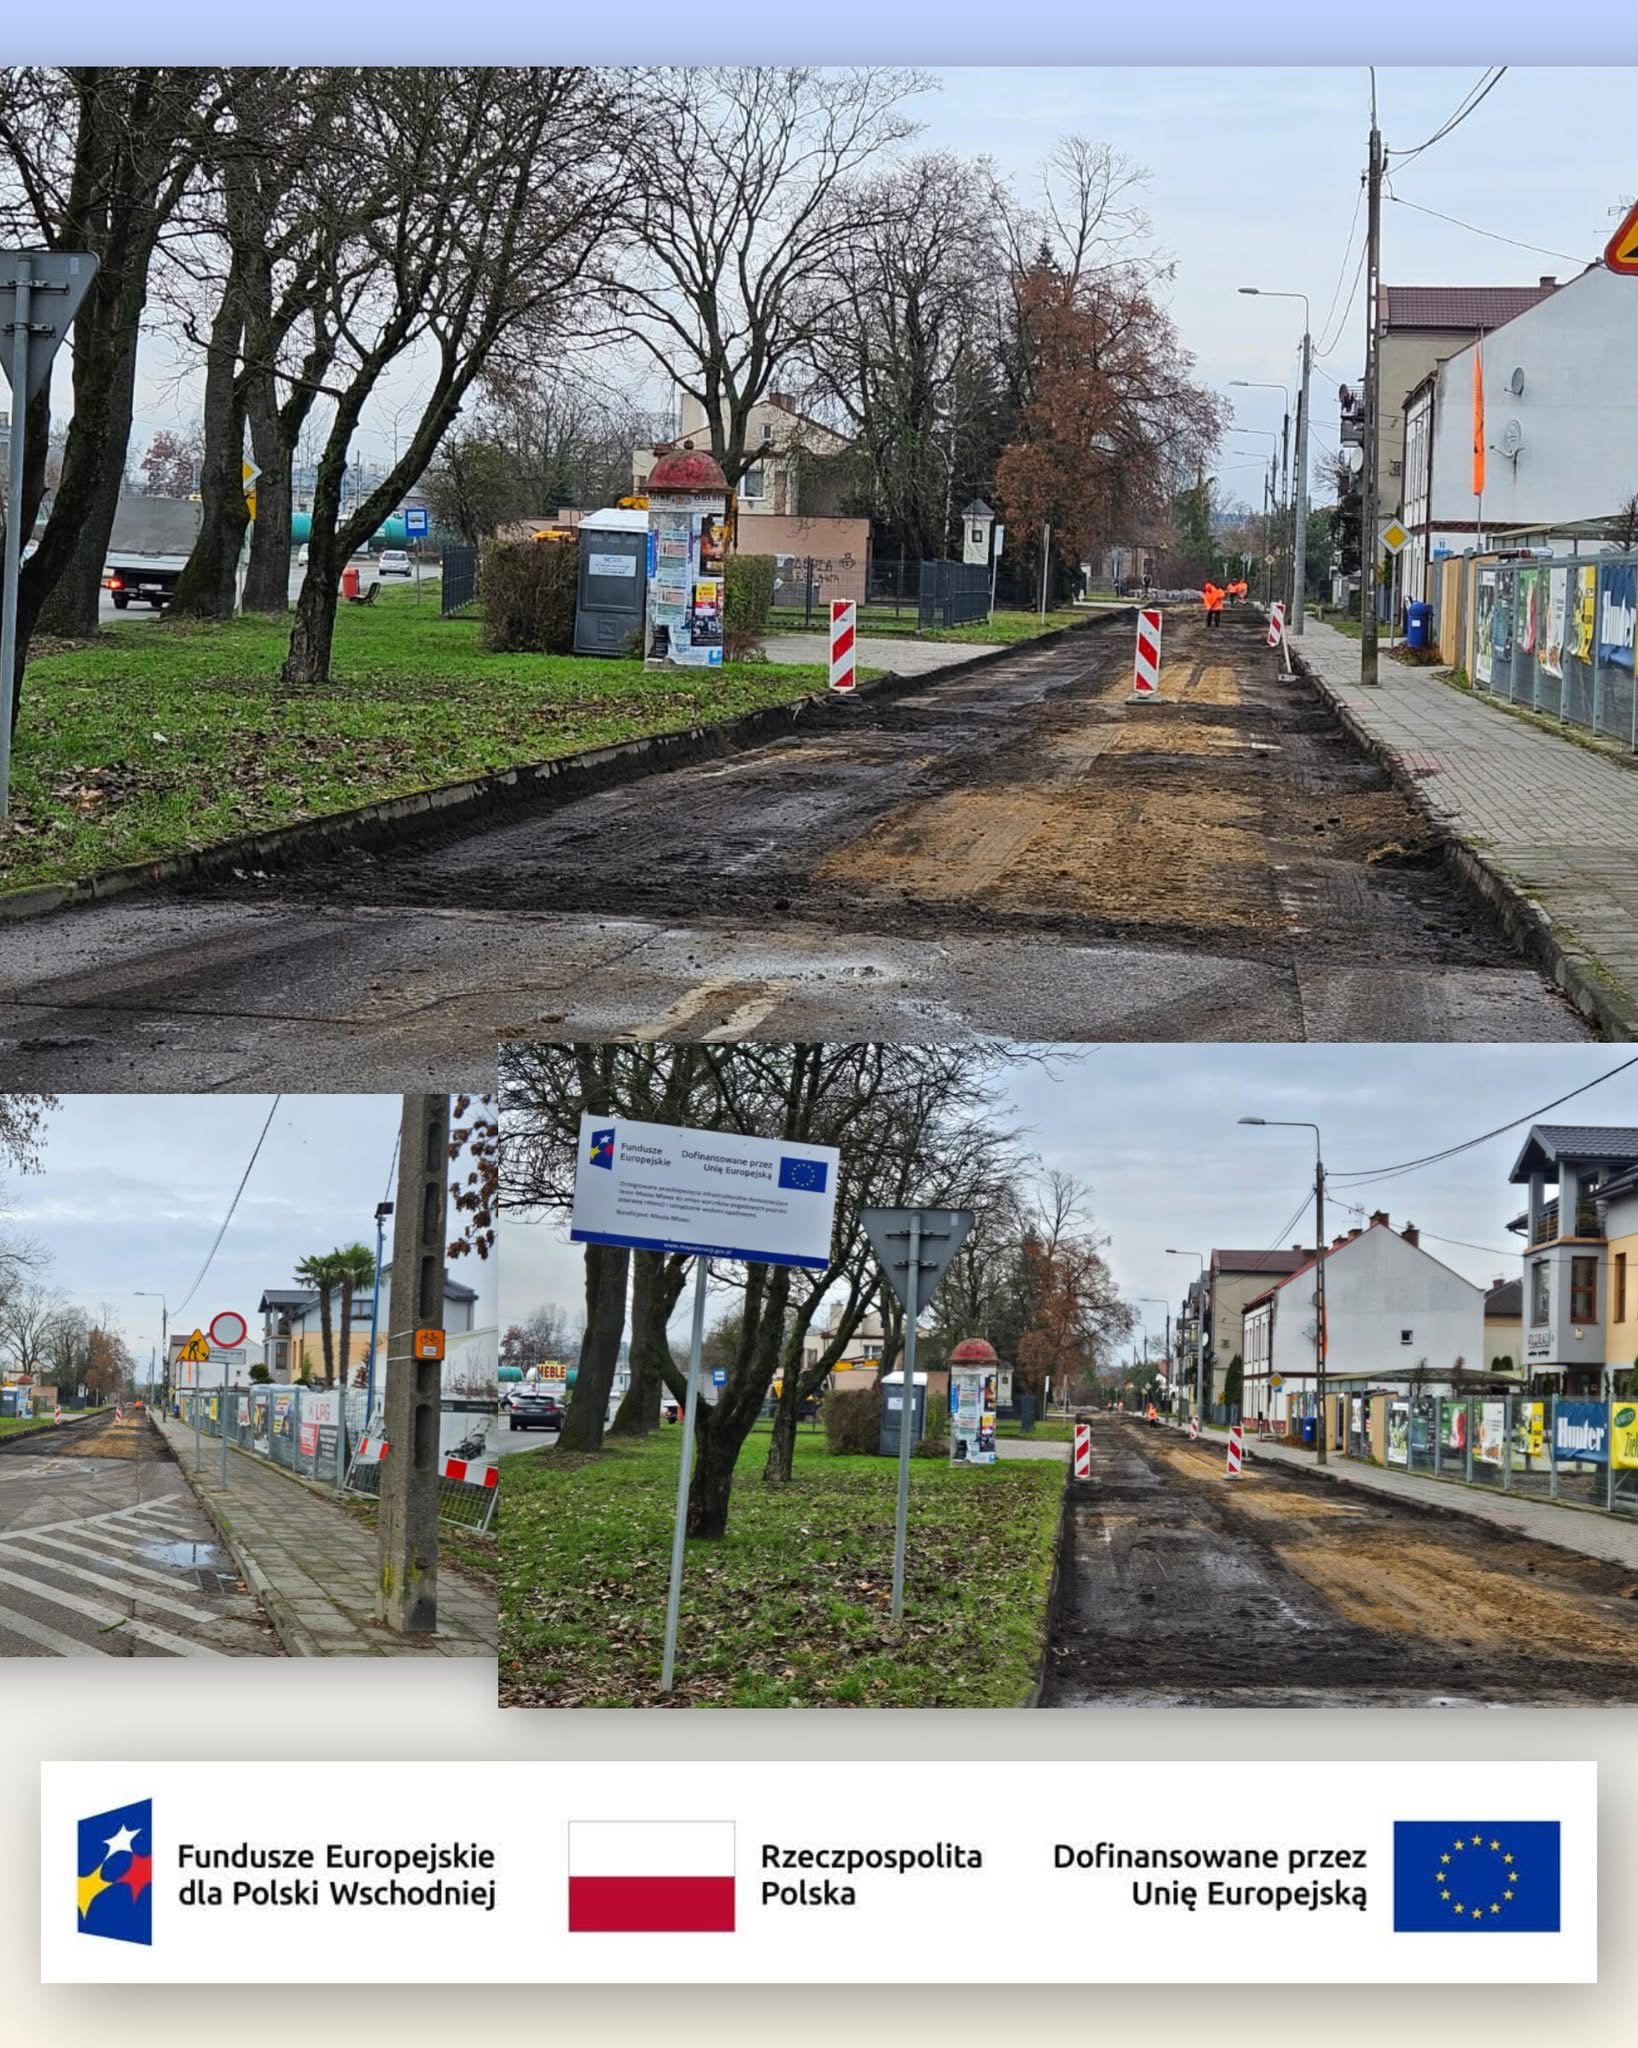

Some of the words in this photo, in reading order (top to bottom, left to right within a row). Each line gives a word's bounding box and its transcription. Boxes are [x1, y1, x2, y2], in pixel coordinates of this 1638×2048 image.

[621, 1142, 662, 1154] Fundusze
[620, 1152, 671, 1167] Europejskie
[681, 1149, 747, 1166] Dofinansowane
[749, 1159, 772, 1170] przez
[703, 1163, 723, 1174] Unię
[725, 1166, 772, 1180] Europejską
[315, 1403, 330, 1421] LPG
